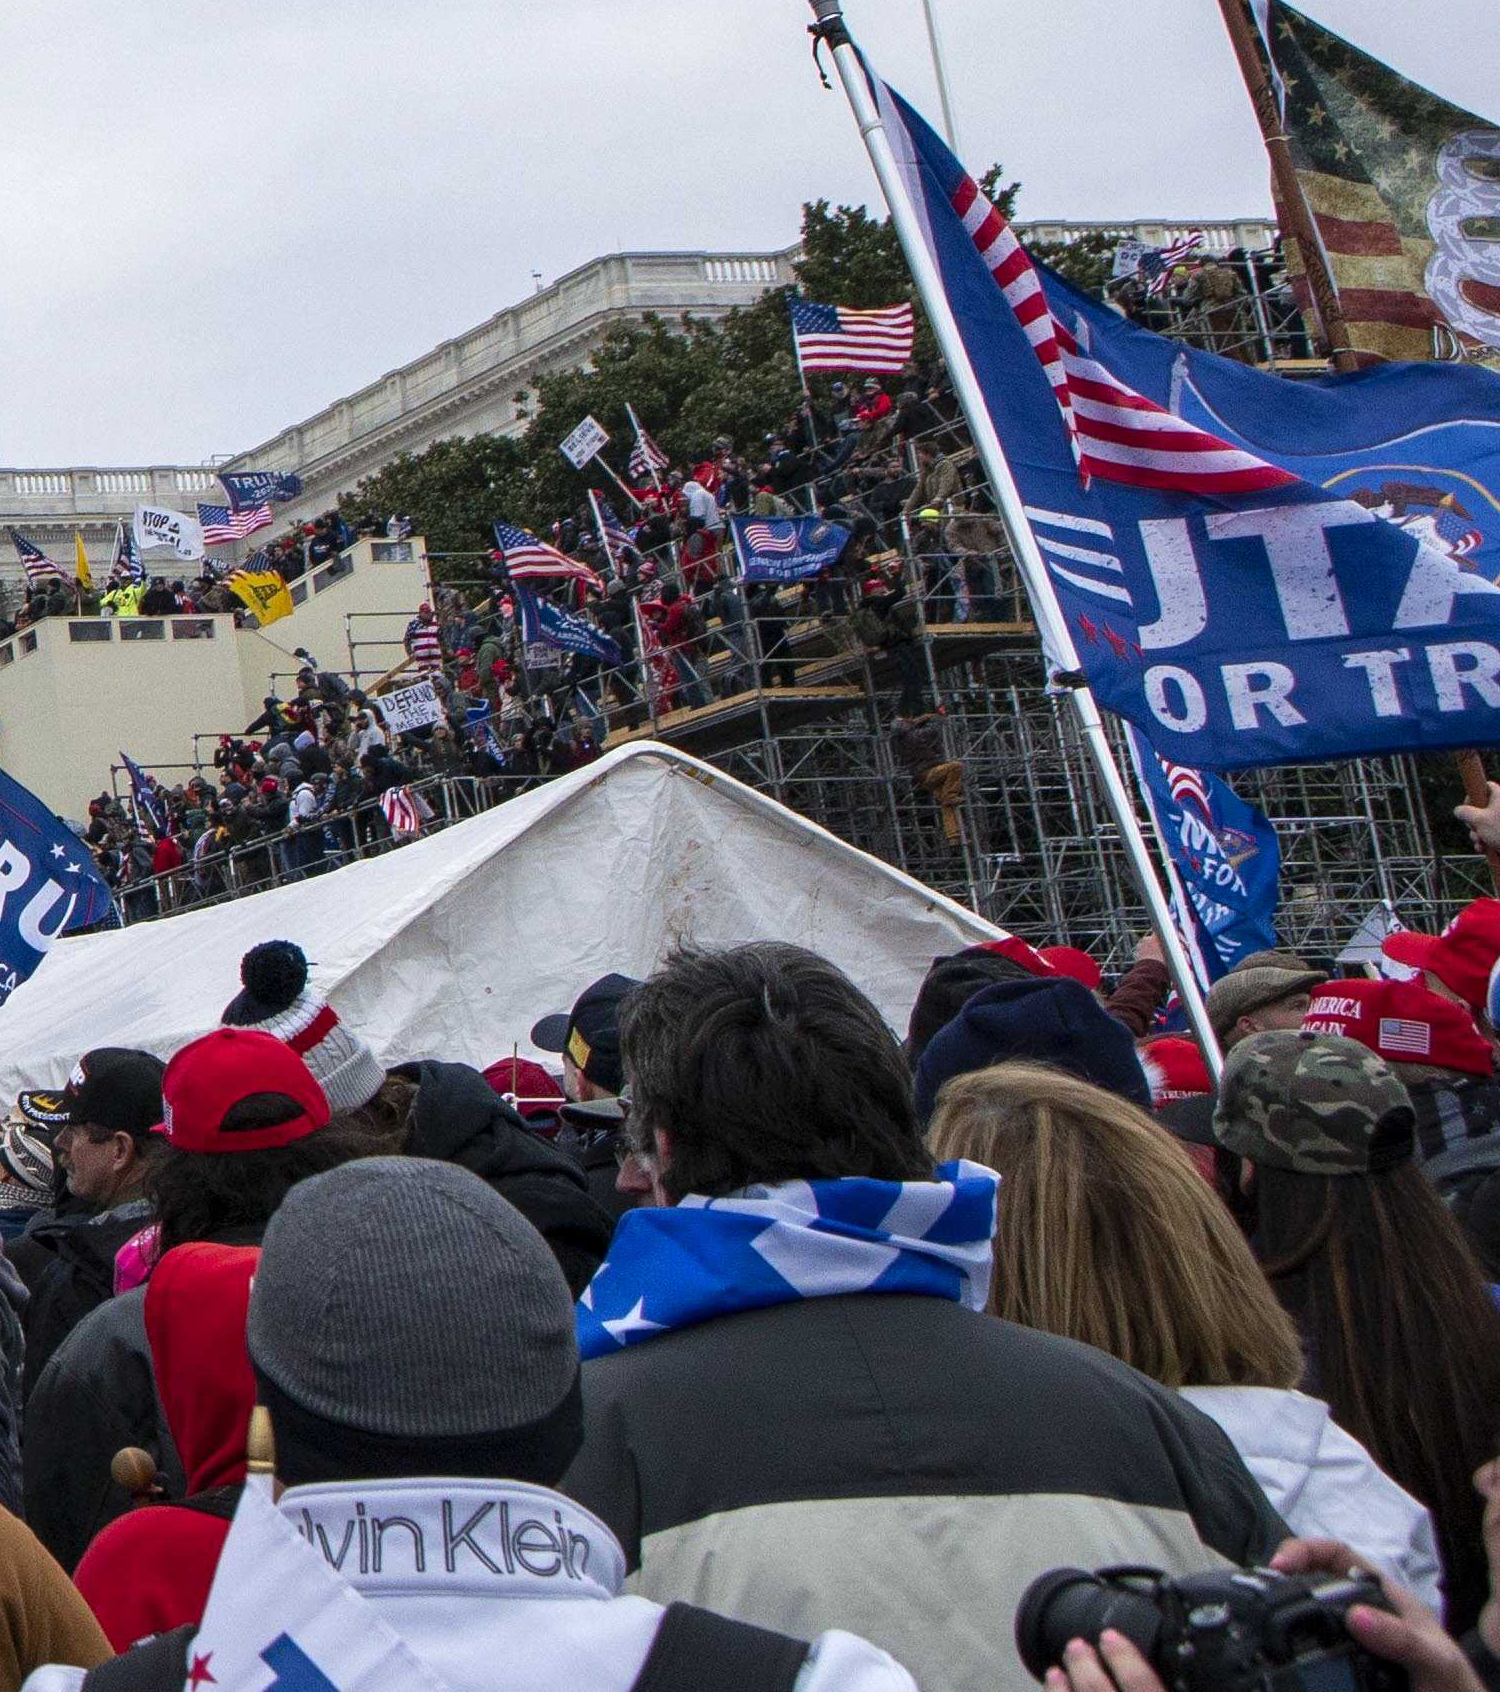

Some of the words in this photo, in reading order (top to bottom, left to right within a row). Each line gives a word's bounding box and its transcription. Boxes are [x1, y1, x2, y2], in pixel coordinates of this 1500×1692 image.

[143, 511, 171, 528] STOP
[1143, 665, 1306, 733] OR
[1309, 997, 1362, 1020] MERICA
[298, 1503, 426, 1575] lvin
[442, 1501, 589, 1578] Klein
